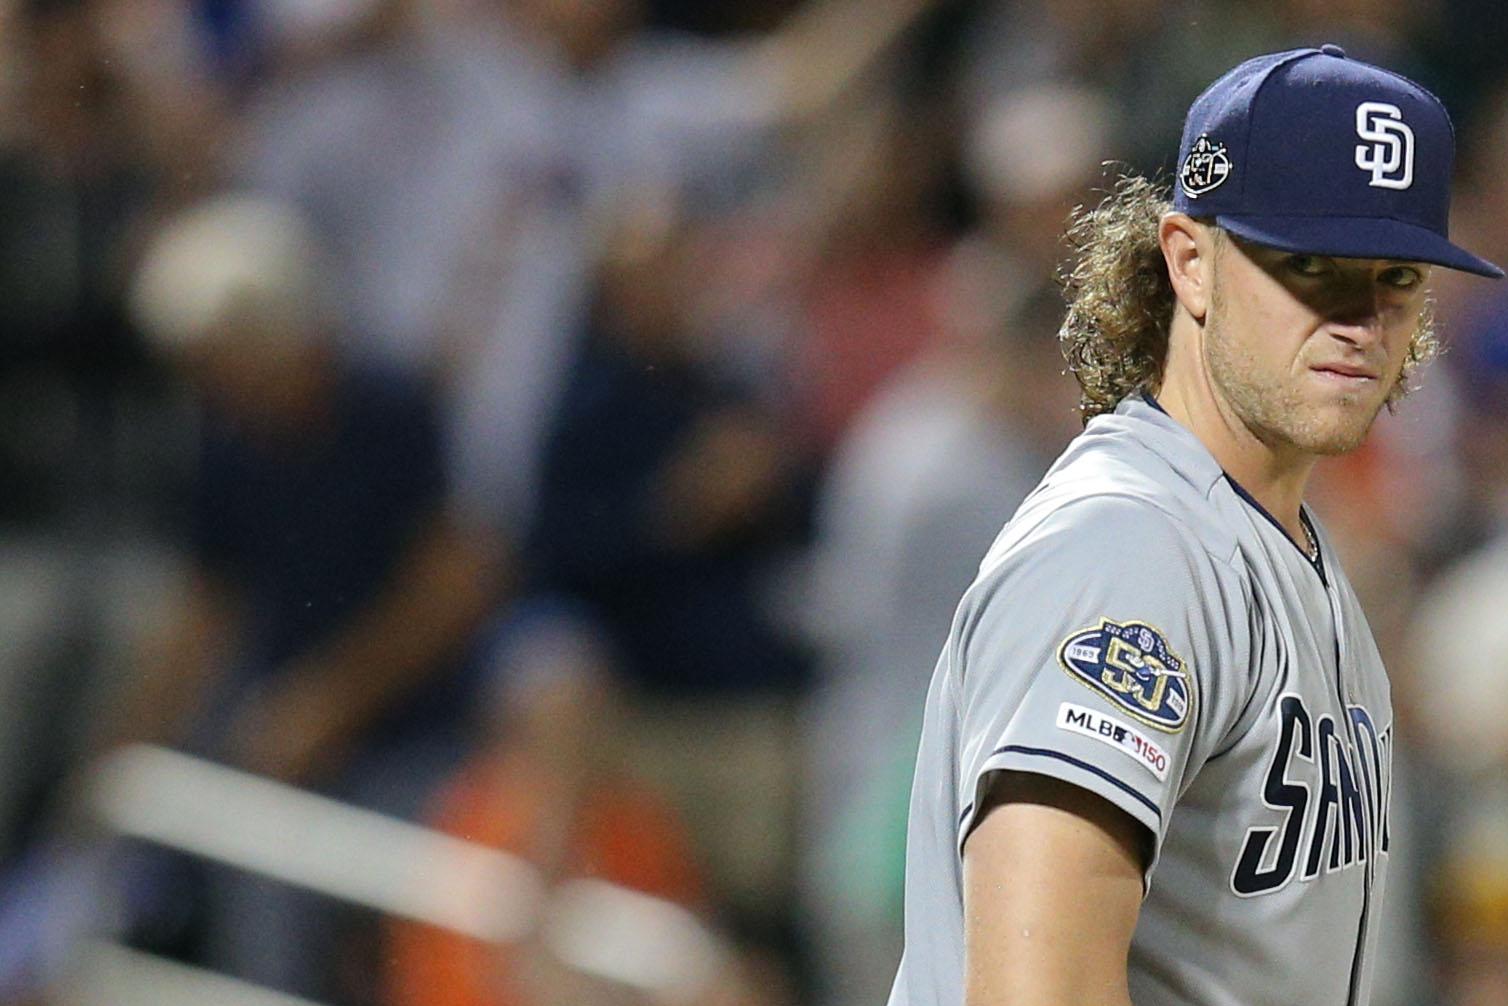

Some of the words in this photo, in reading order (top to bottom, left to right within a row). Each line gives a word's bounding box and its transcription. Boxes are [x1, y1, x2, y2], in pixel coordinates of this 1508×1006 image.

[1354, 101, 1415, 190] SD
[1137, 627, 1155, 653] SD
[1065, 708, 1113, 736] MLB
[1143, 740, 1167, 773] 150
